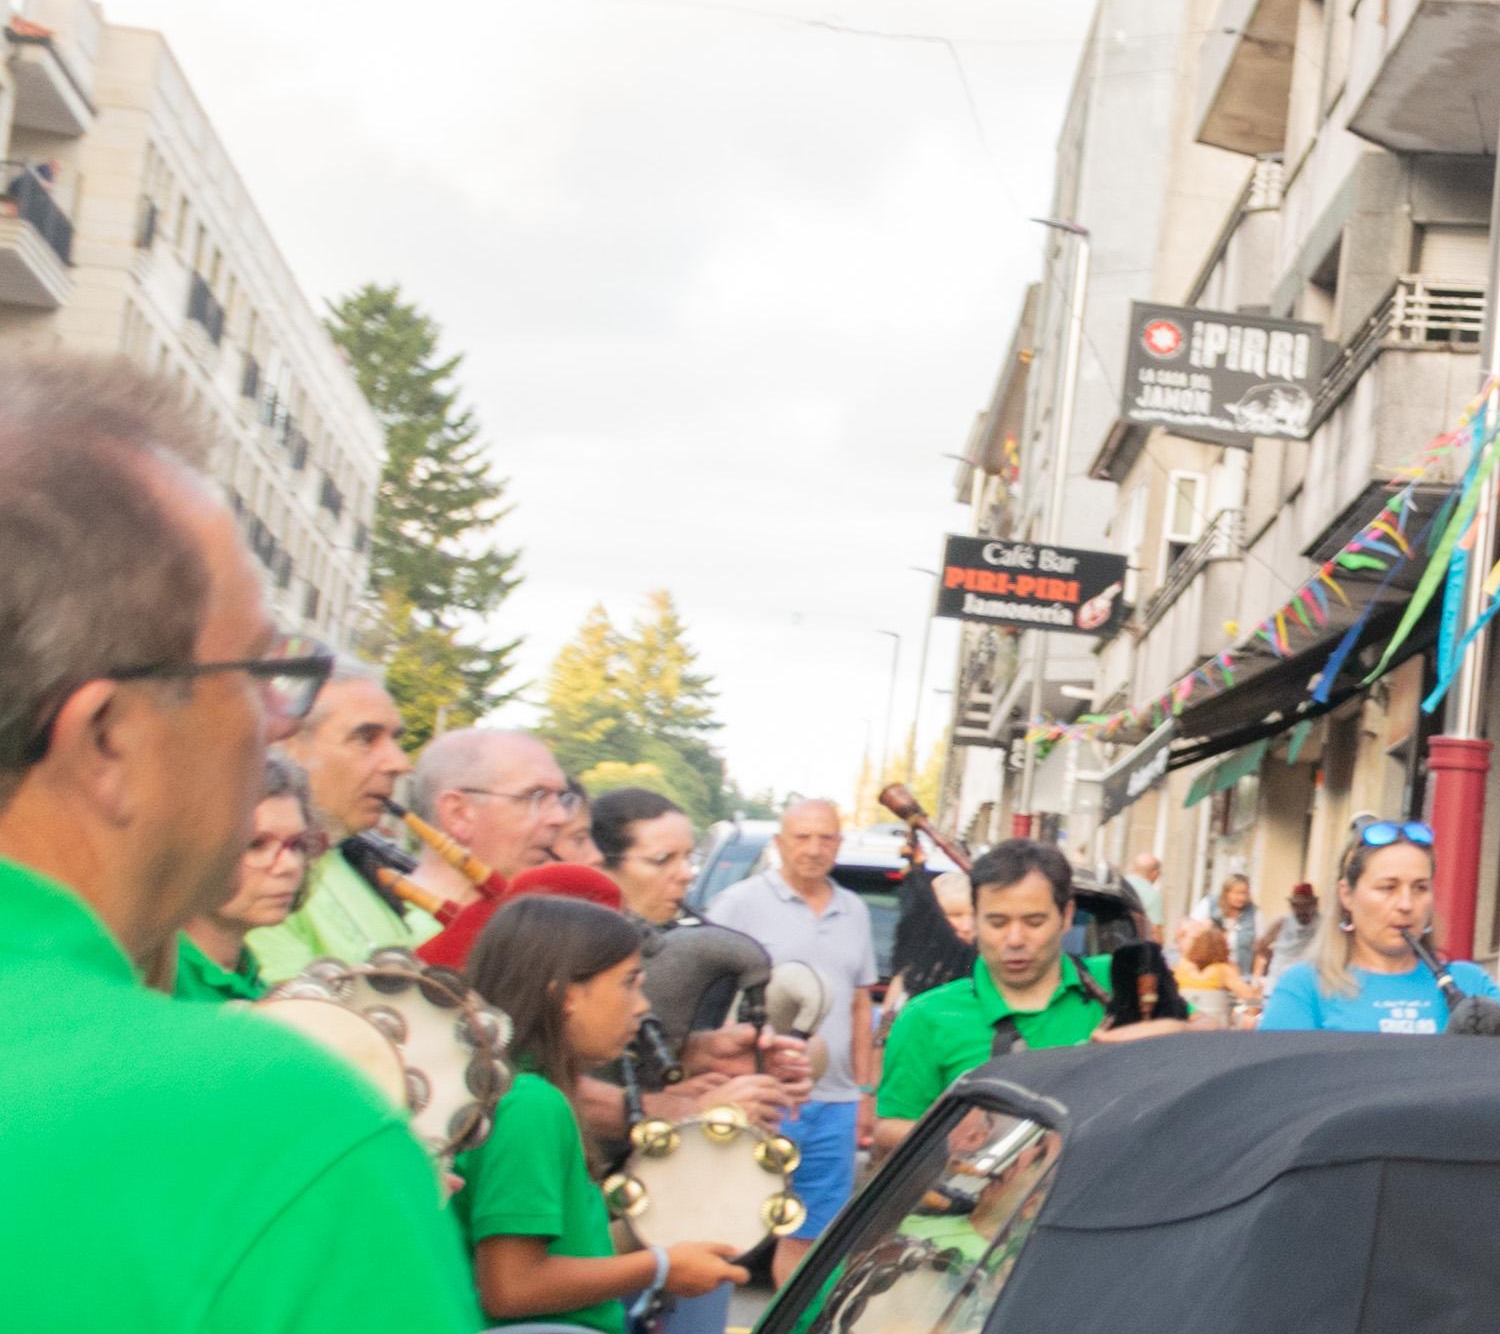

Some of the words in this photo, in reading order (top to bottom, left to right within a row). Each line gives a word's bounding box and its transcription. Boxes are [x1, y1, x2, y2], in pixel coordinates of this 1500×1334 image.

[982, 542, 1036, 570] Café
[1038, 549, 1079, 574] Bar
[944, 565, 1081, 604] PIRI-PIRI
